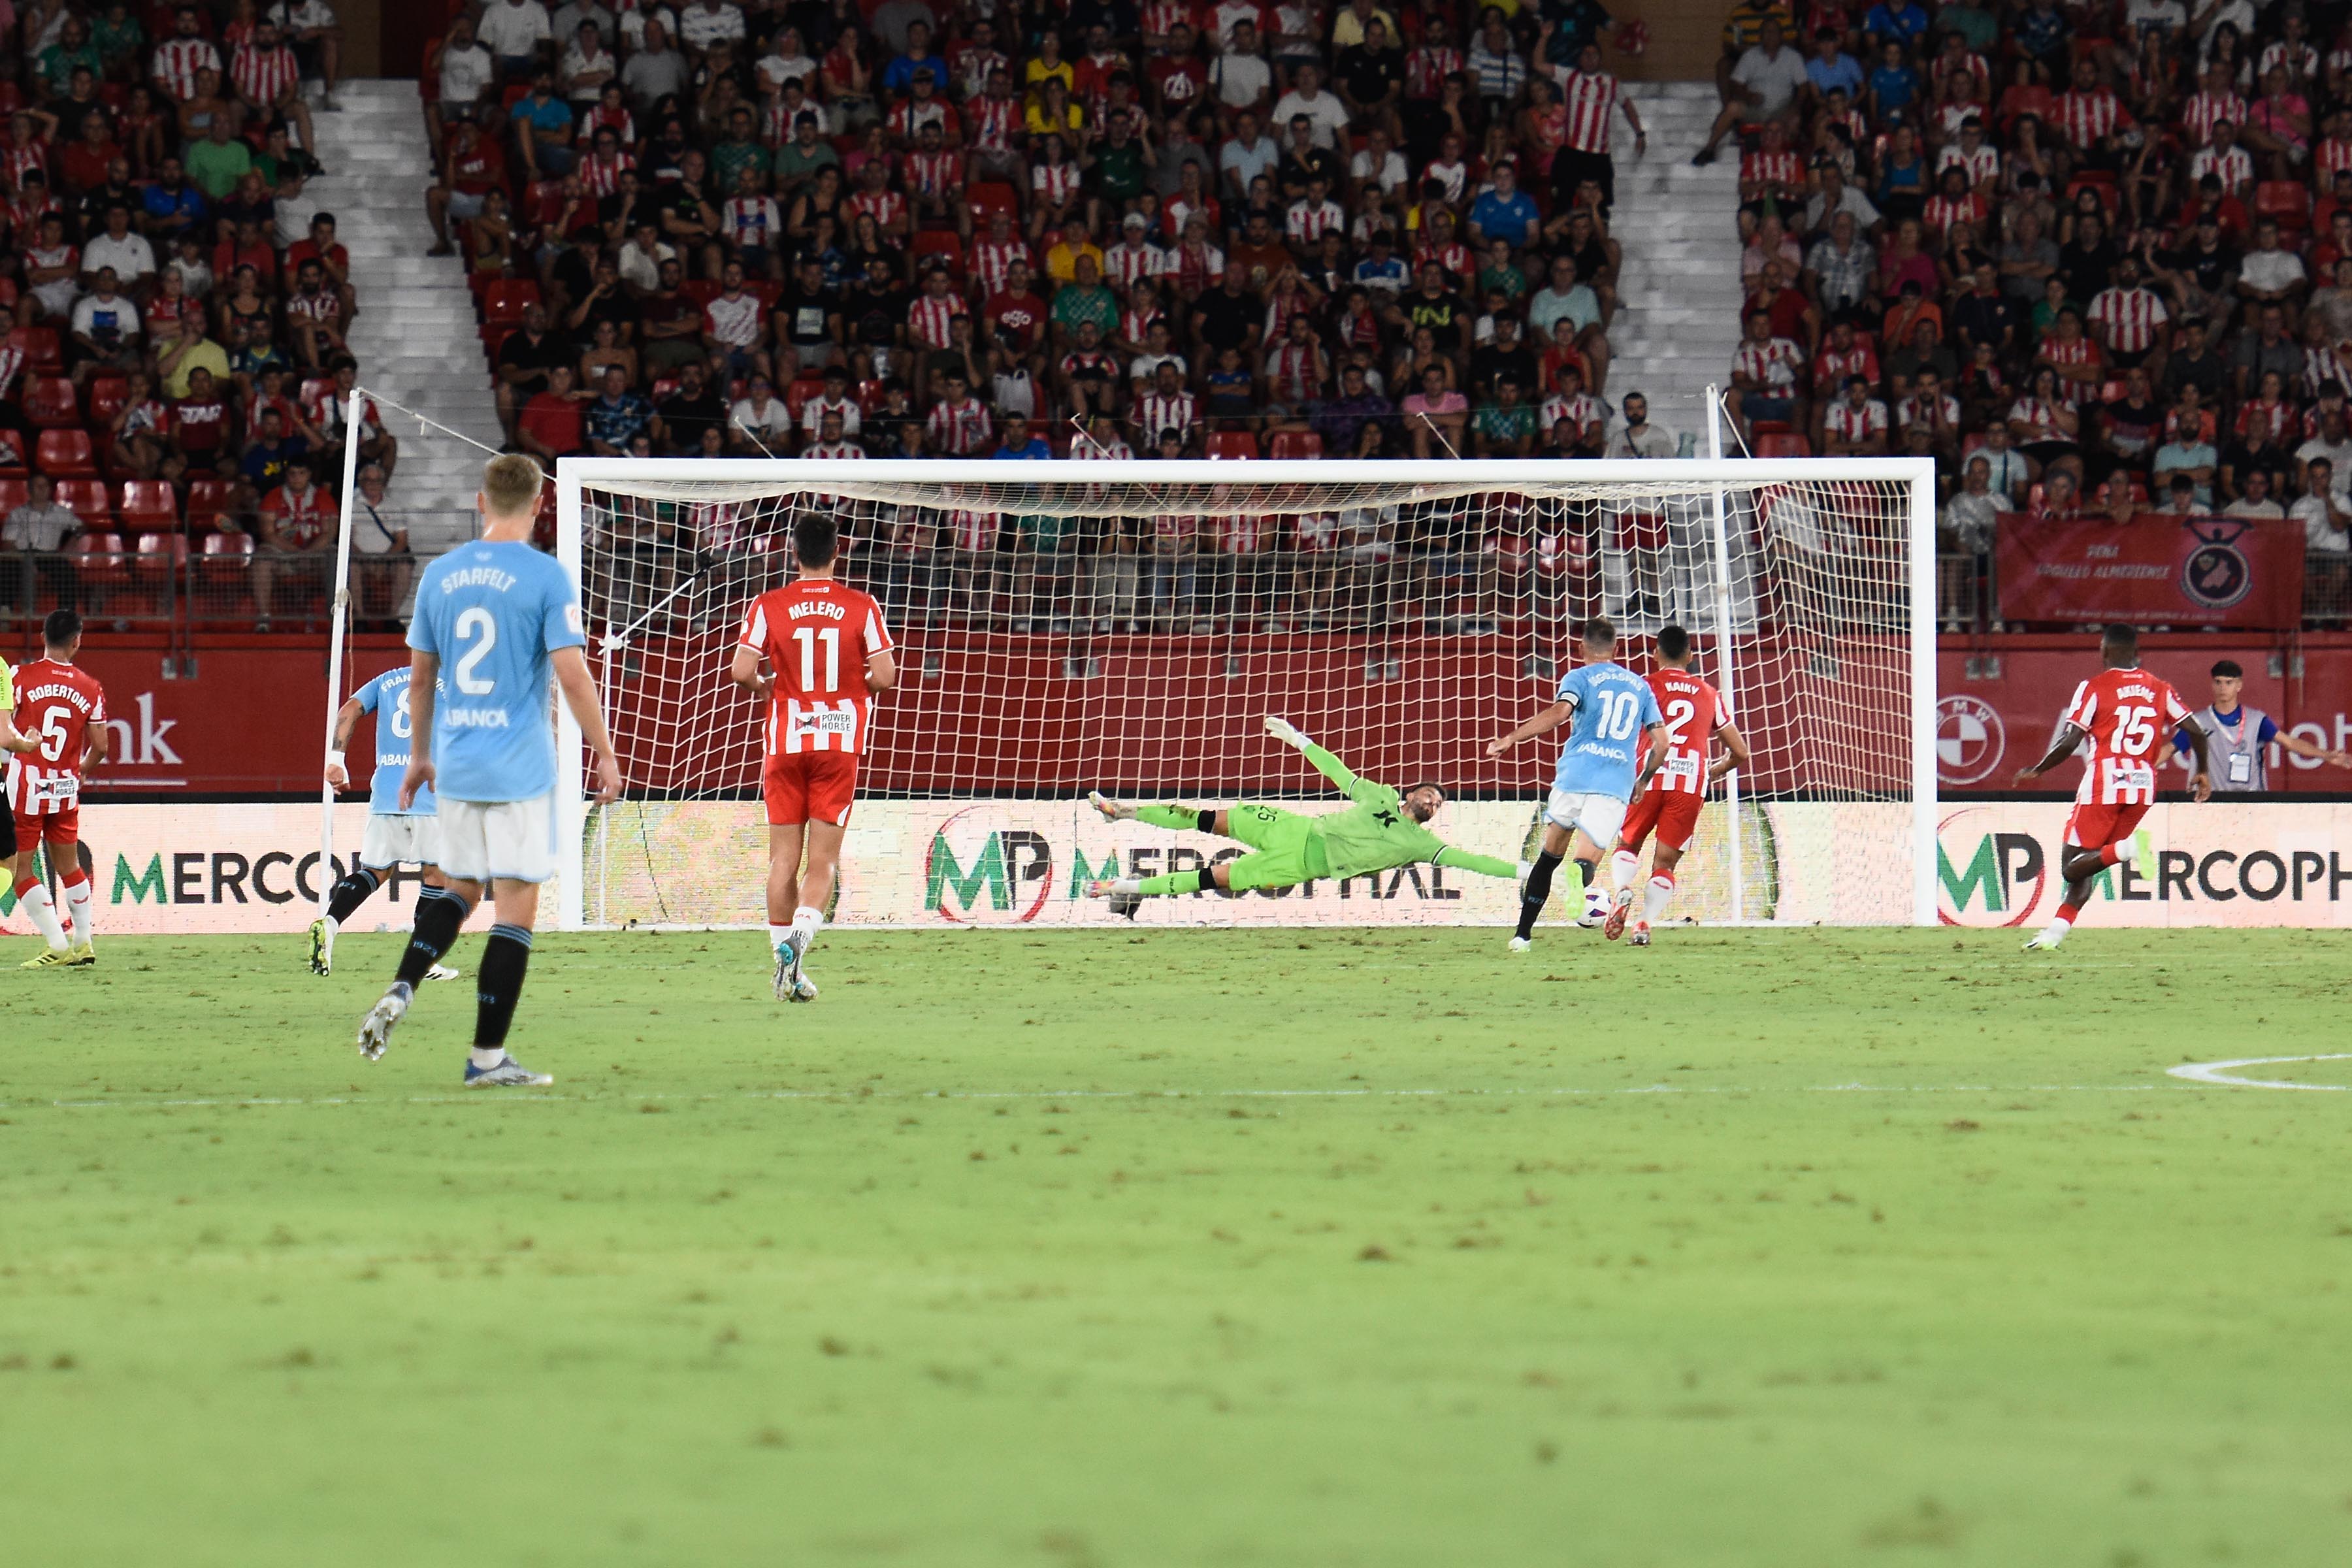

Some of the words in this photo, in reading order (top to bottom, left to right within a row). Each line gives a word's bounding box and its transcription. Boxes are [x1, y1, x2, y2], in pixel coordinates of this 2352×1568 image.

[441, 568, 517, 594] STARFELT
[789, 601, 845, 621] MELERO
[456, 607, 495, 694] 2
[792, 627, 840, 693] 11
[27, 684, 91, 714] ROBERTONE
[1665, 681, 1699, 695] KAIKY
[445, 709, 508, 727] ABANCA
[822, 713, 851, 723] POWER
[822, 723, 851, 731] HORSE
[1597, 690, 1639, 740] 10
[1667, 699, 1694, 744] 2
[41, 706, 72, 762] 5
[2110, 706, 2157, 756] 15
[381, 755, 411, 766] ABAN
[1578, 743, 1627, 762] ABANCA
[924, 831, 1049, 910] MP
